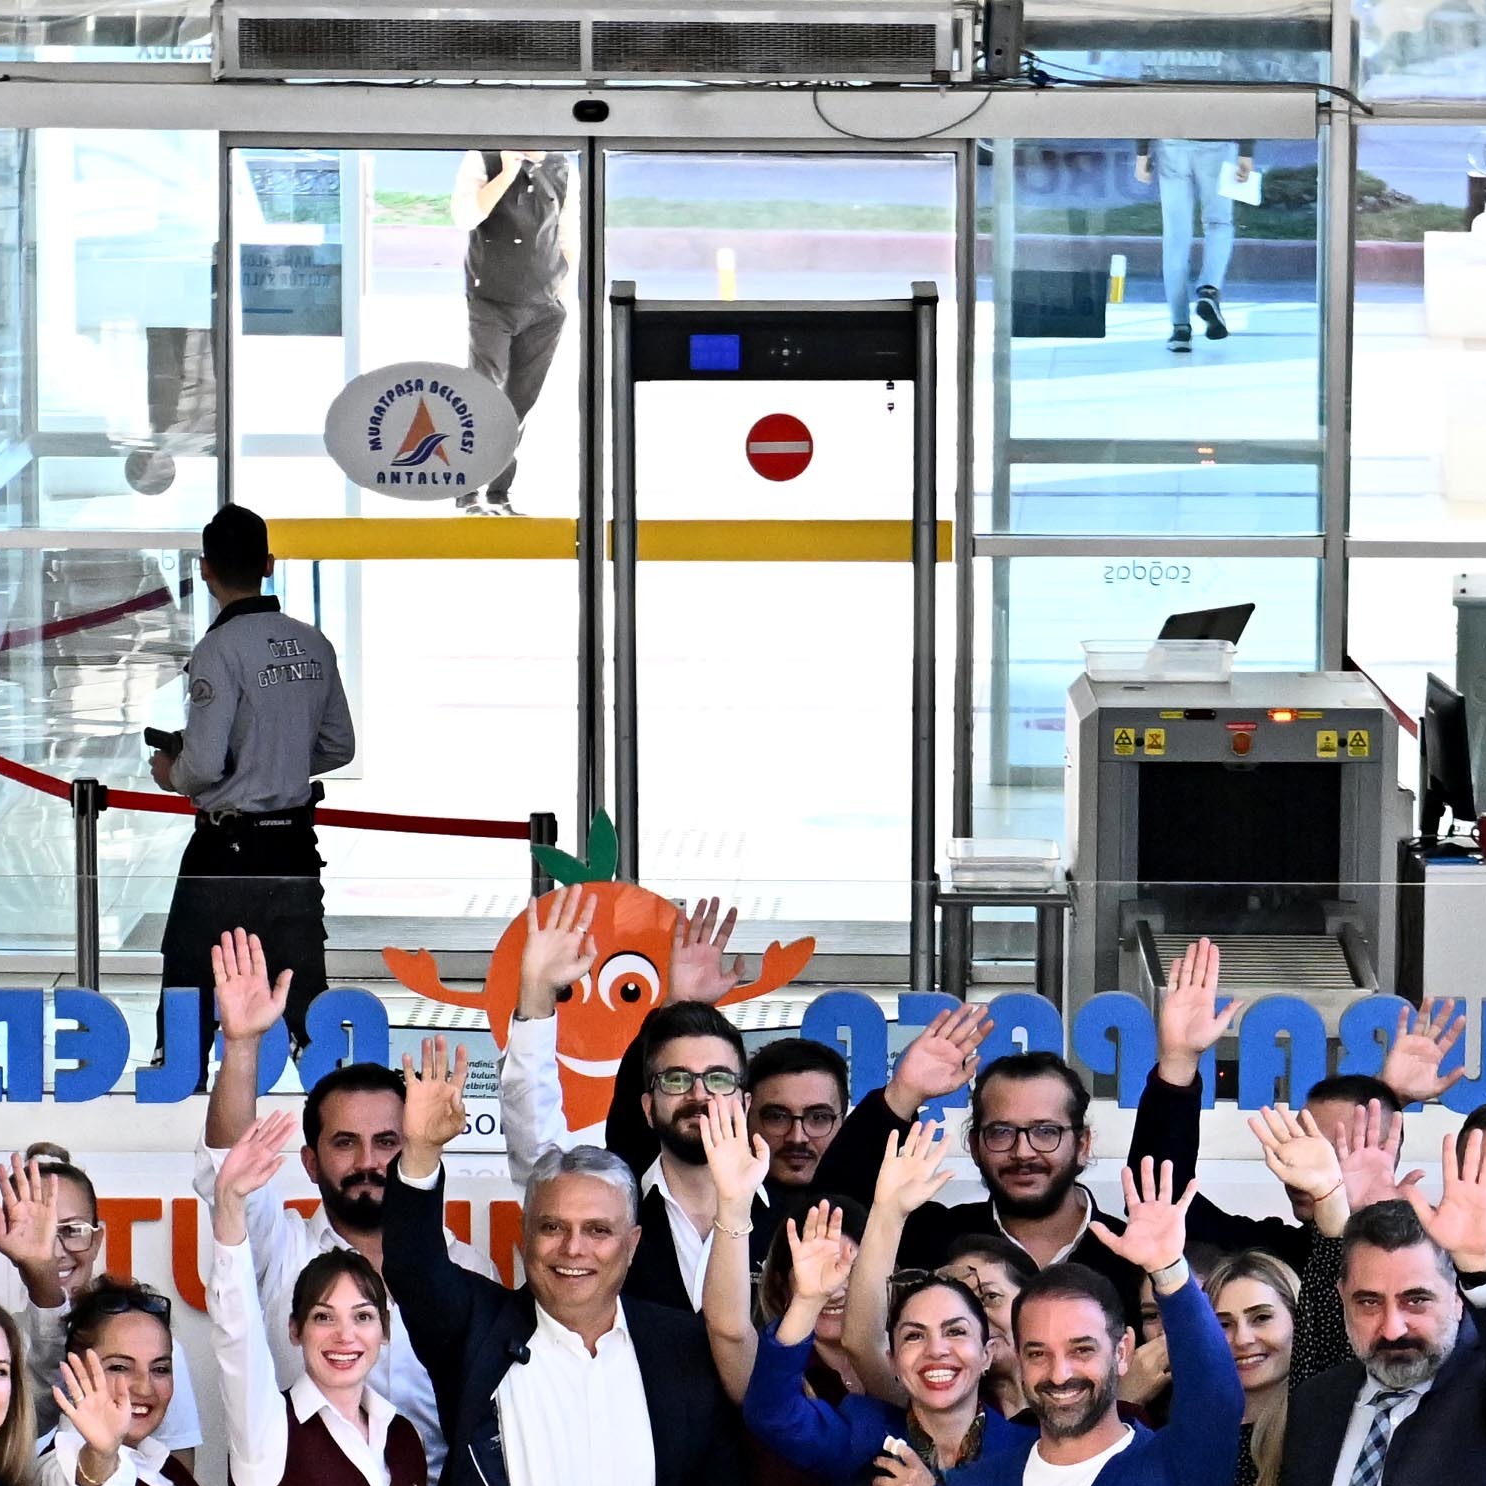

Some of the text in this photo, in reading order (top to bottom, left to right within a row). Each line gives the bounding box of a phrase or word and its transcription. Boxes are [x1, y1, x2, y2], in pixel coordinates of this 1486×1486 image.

[368, 379, 424, 452] MURATPAŞA
[377, 471, 466, 485] ANTALYA
[267, 638, 306, 658] ÖZEL
